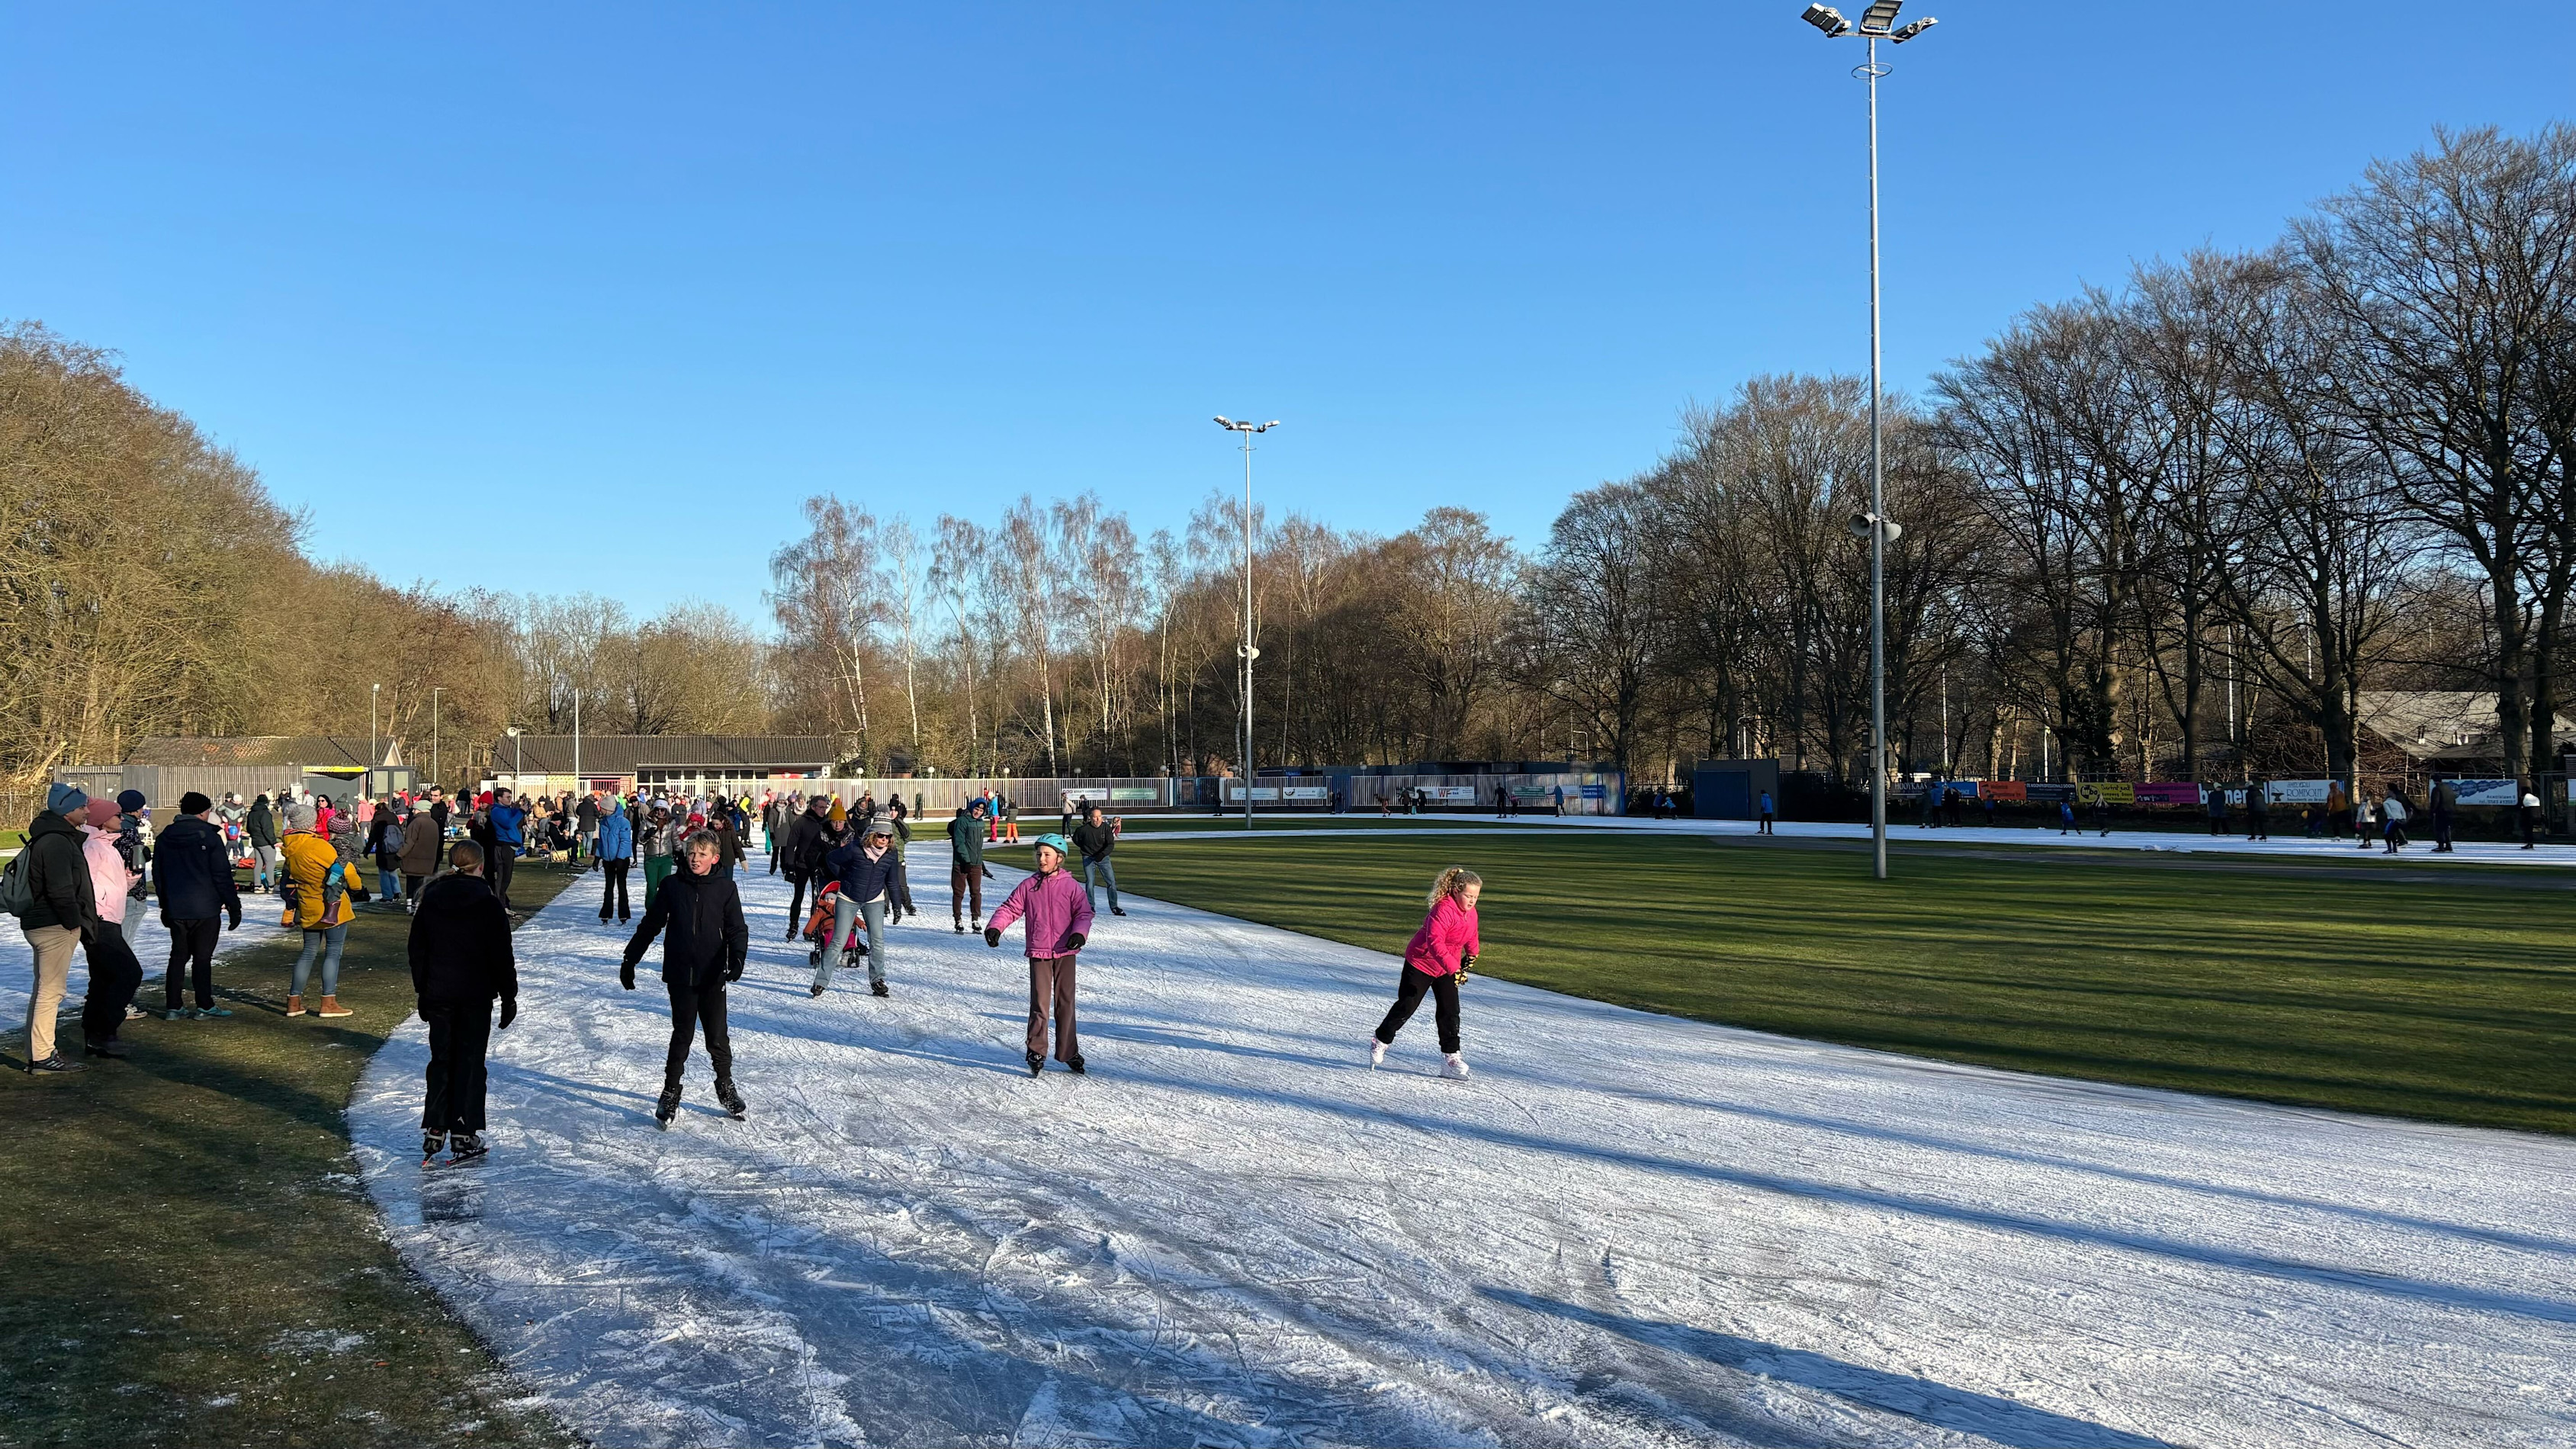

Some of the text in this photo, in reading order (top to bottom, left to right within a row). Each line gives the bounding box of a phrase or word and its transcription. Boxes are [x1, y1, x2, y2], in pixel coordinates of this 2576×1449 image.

[1894, 782, 1928, 790] HOOYKAAS
[2082, 786, 2098, 795] hubo
[2286, 789, 2323, 797] ROMBOUT
